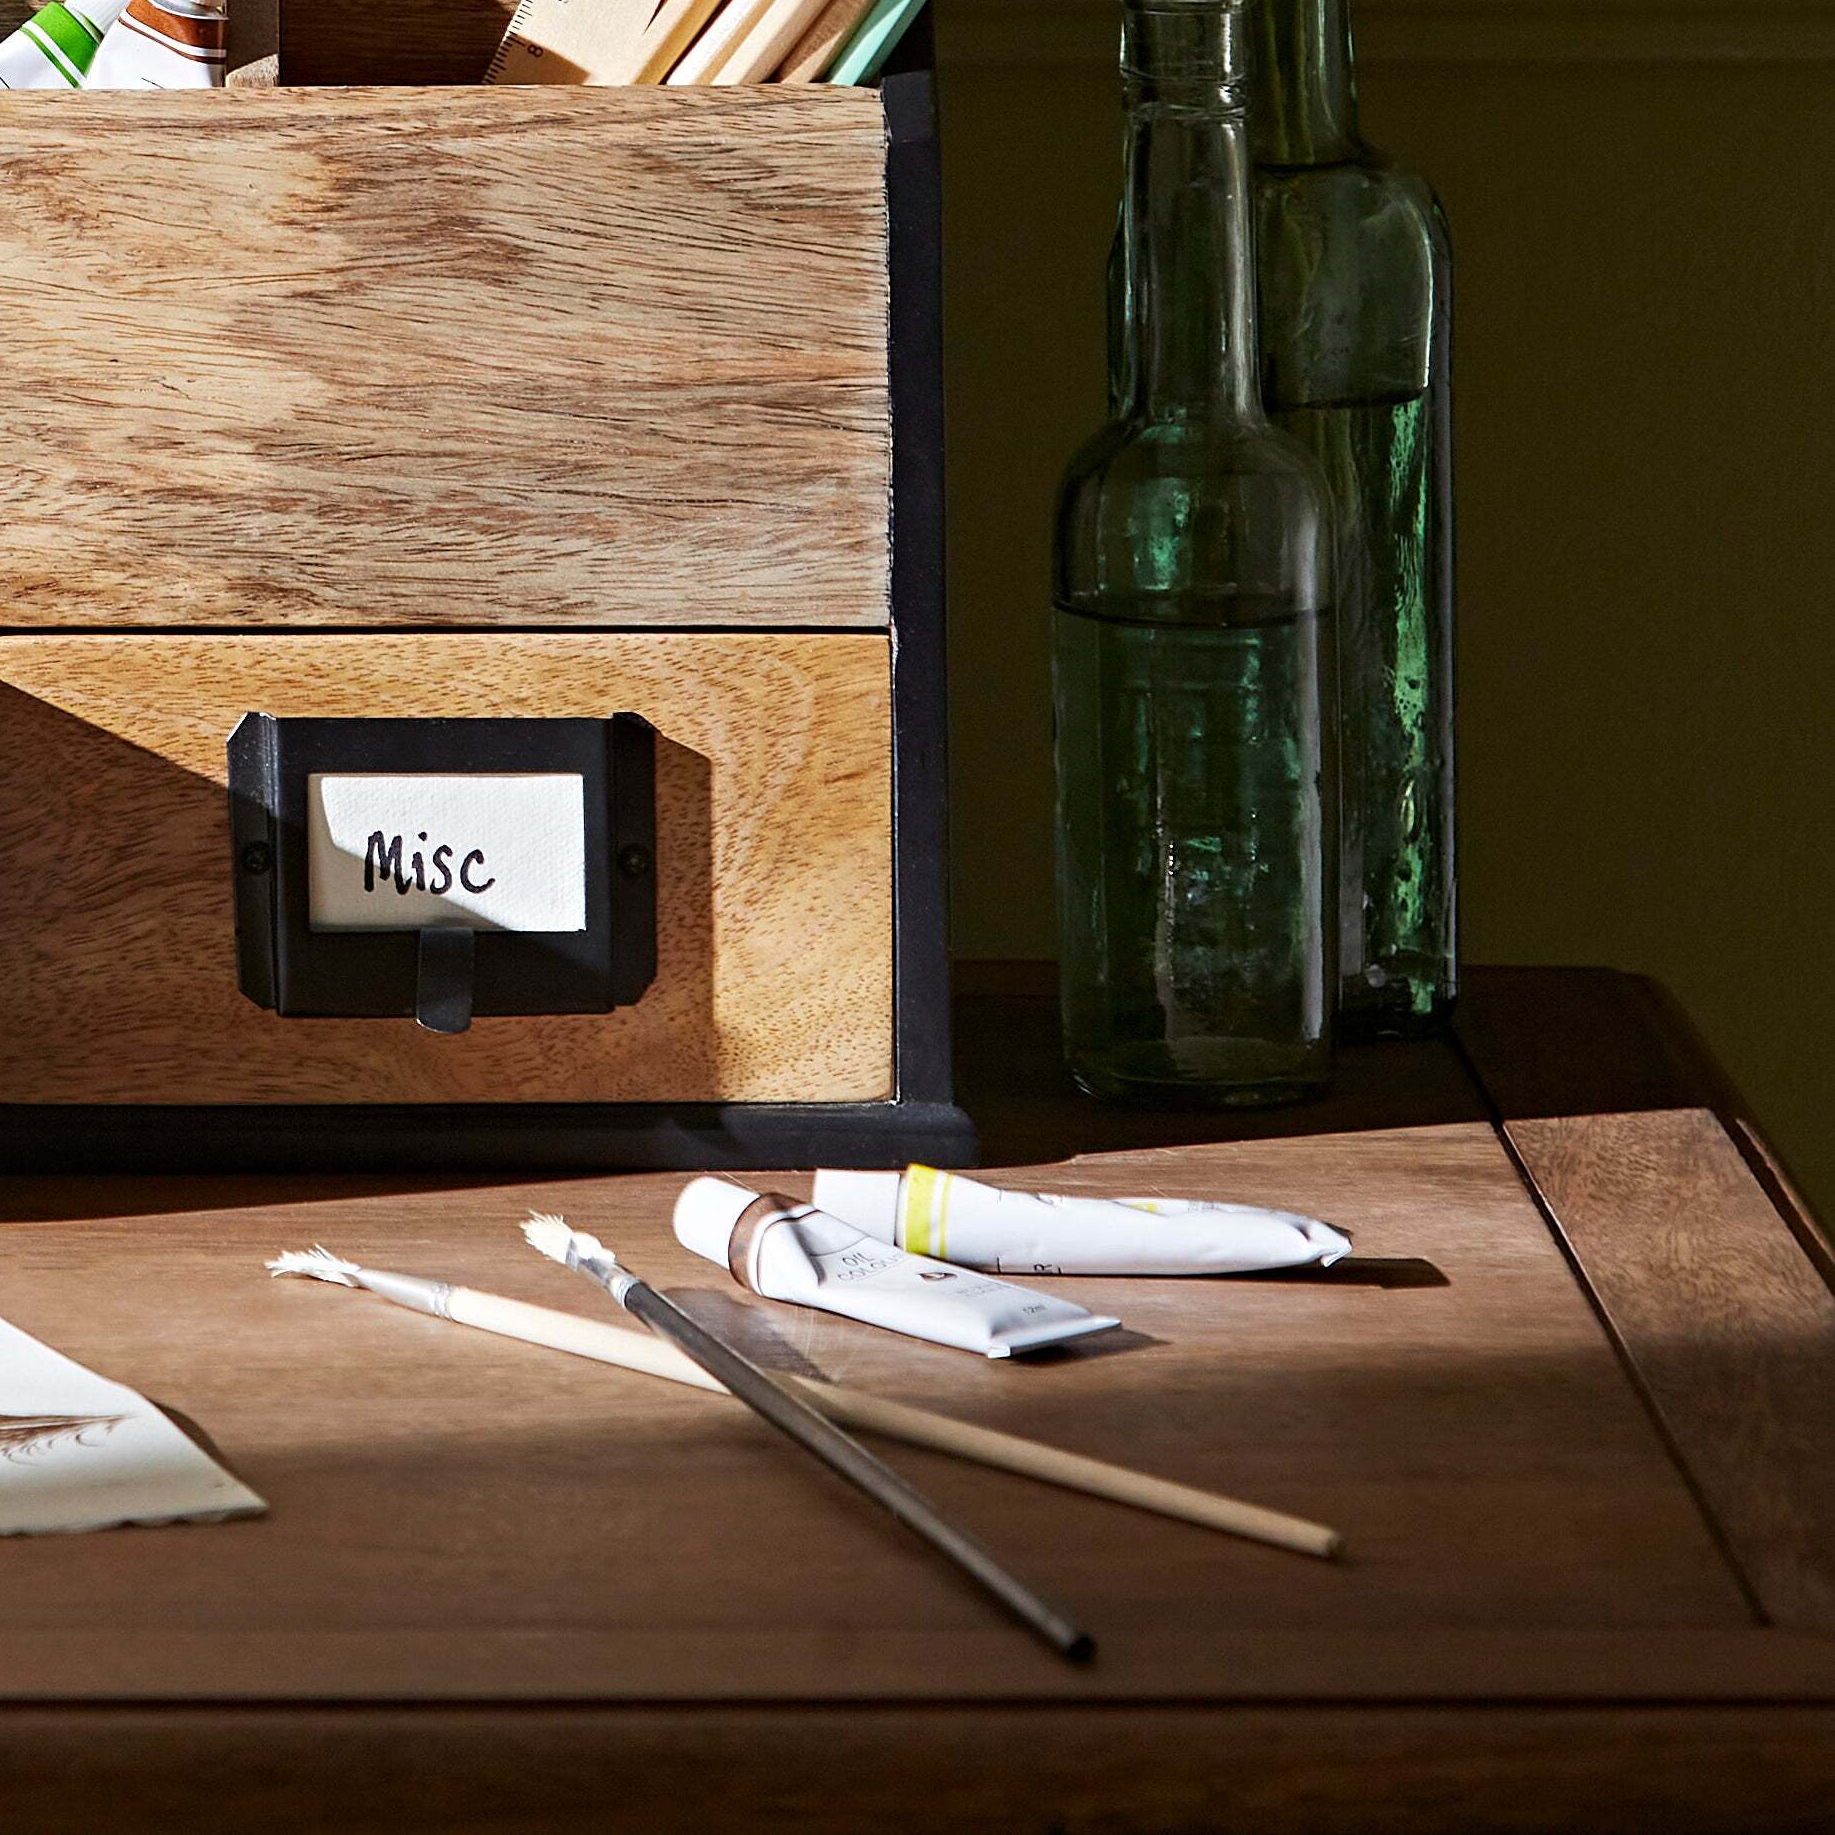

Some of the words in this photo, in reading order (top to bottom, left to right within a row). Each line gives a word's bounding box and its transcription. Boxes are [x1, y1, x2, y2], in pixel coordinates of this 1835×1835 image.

[527, 44, 544, 58] 8
[364, 830, 496, 895] Misc
[842, 1252, 875, 1266] OIL
